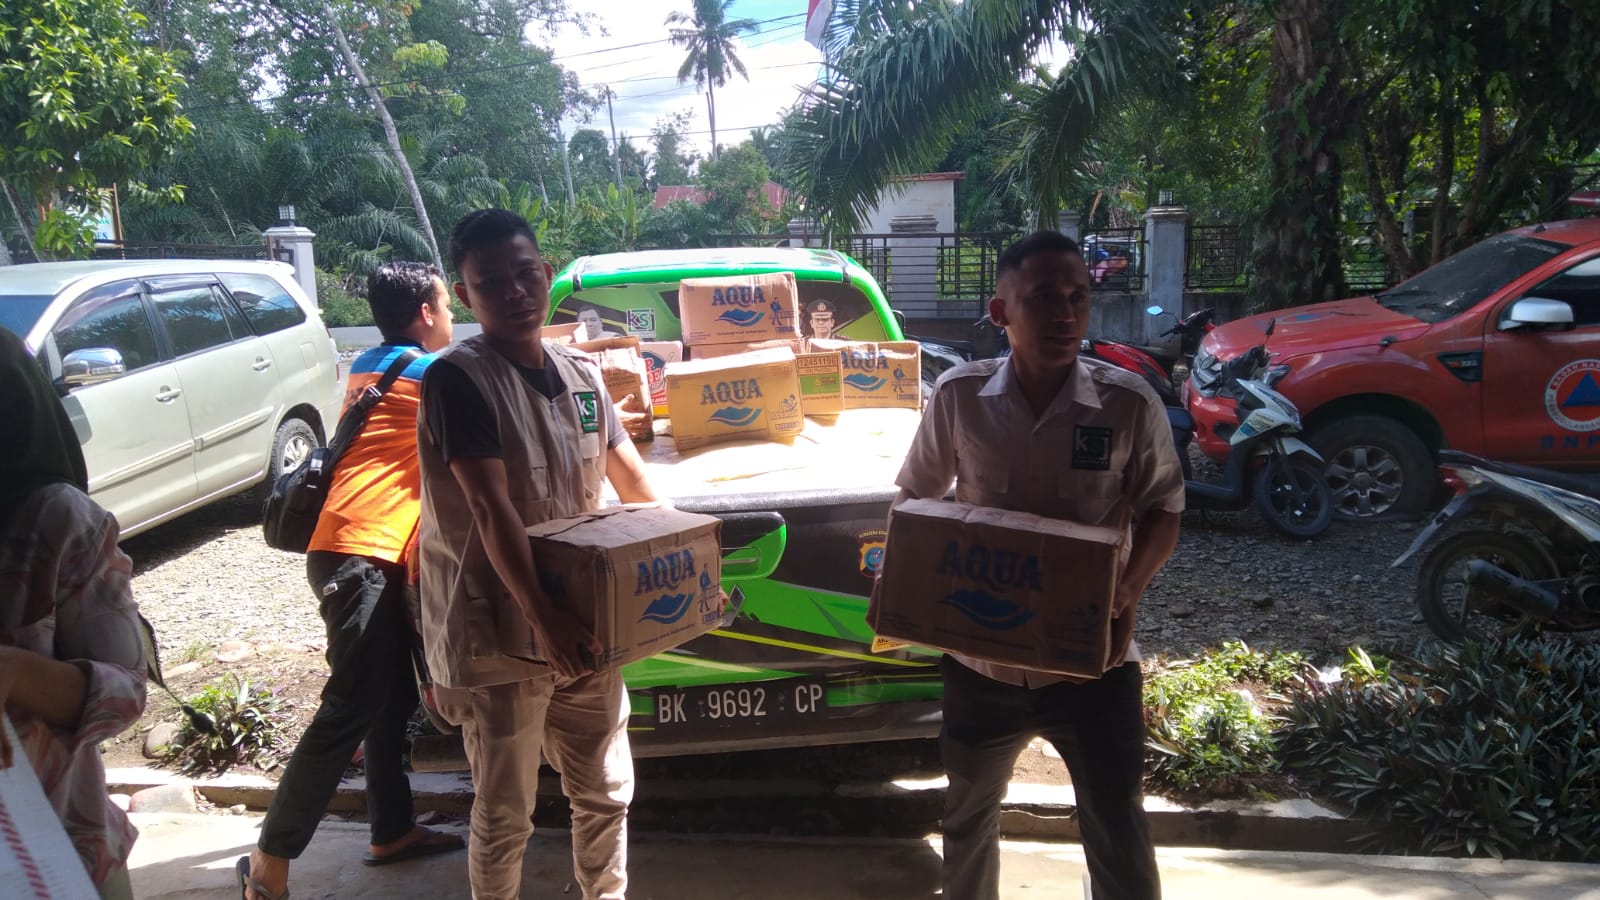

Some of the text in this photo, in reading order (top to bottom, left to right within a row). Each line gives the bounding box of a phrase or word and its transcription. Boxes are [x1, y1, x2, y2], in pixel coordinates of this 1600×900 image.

[712, 285, 765, 307] AQUA
[700, 378, 762, 405] AQUA
[634, 548, 696, 596] AQUA
[934, 540, 1043, 593] AQUA
[658, 684, 823, 723] BK 9692 CP
